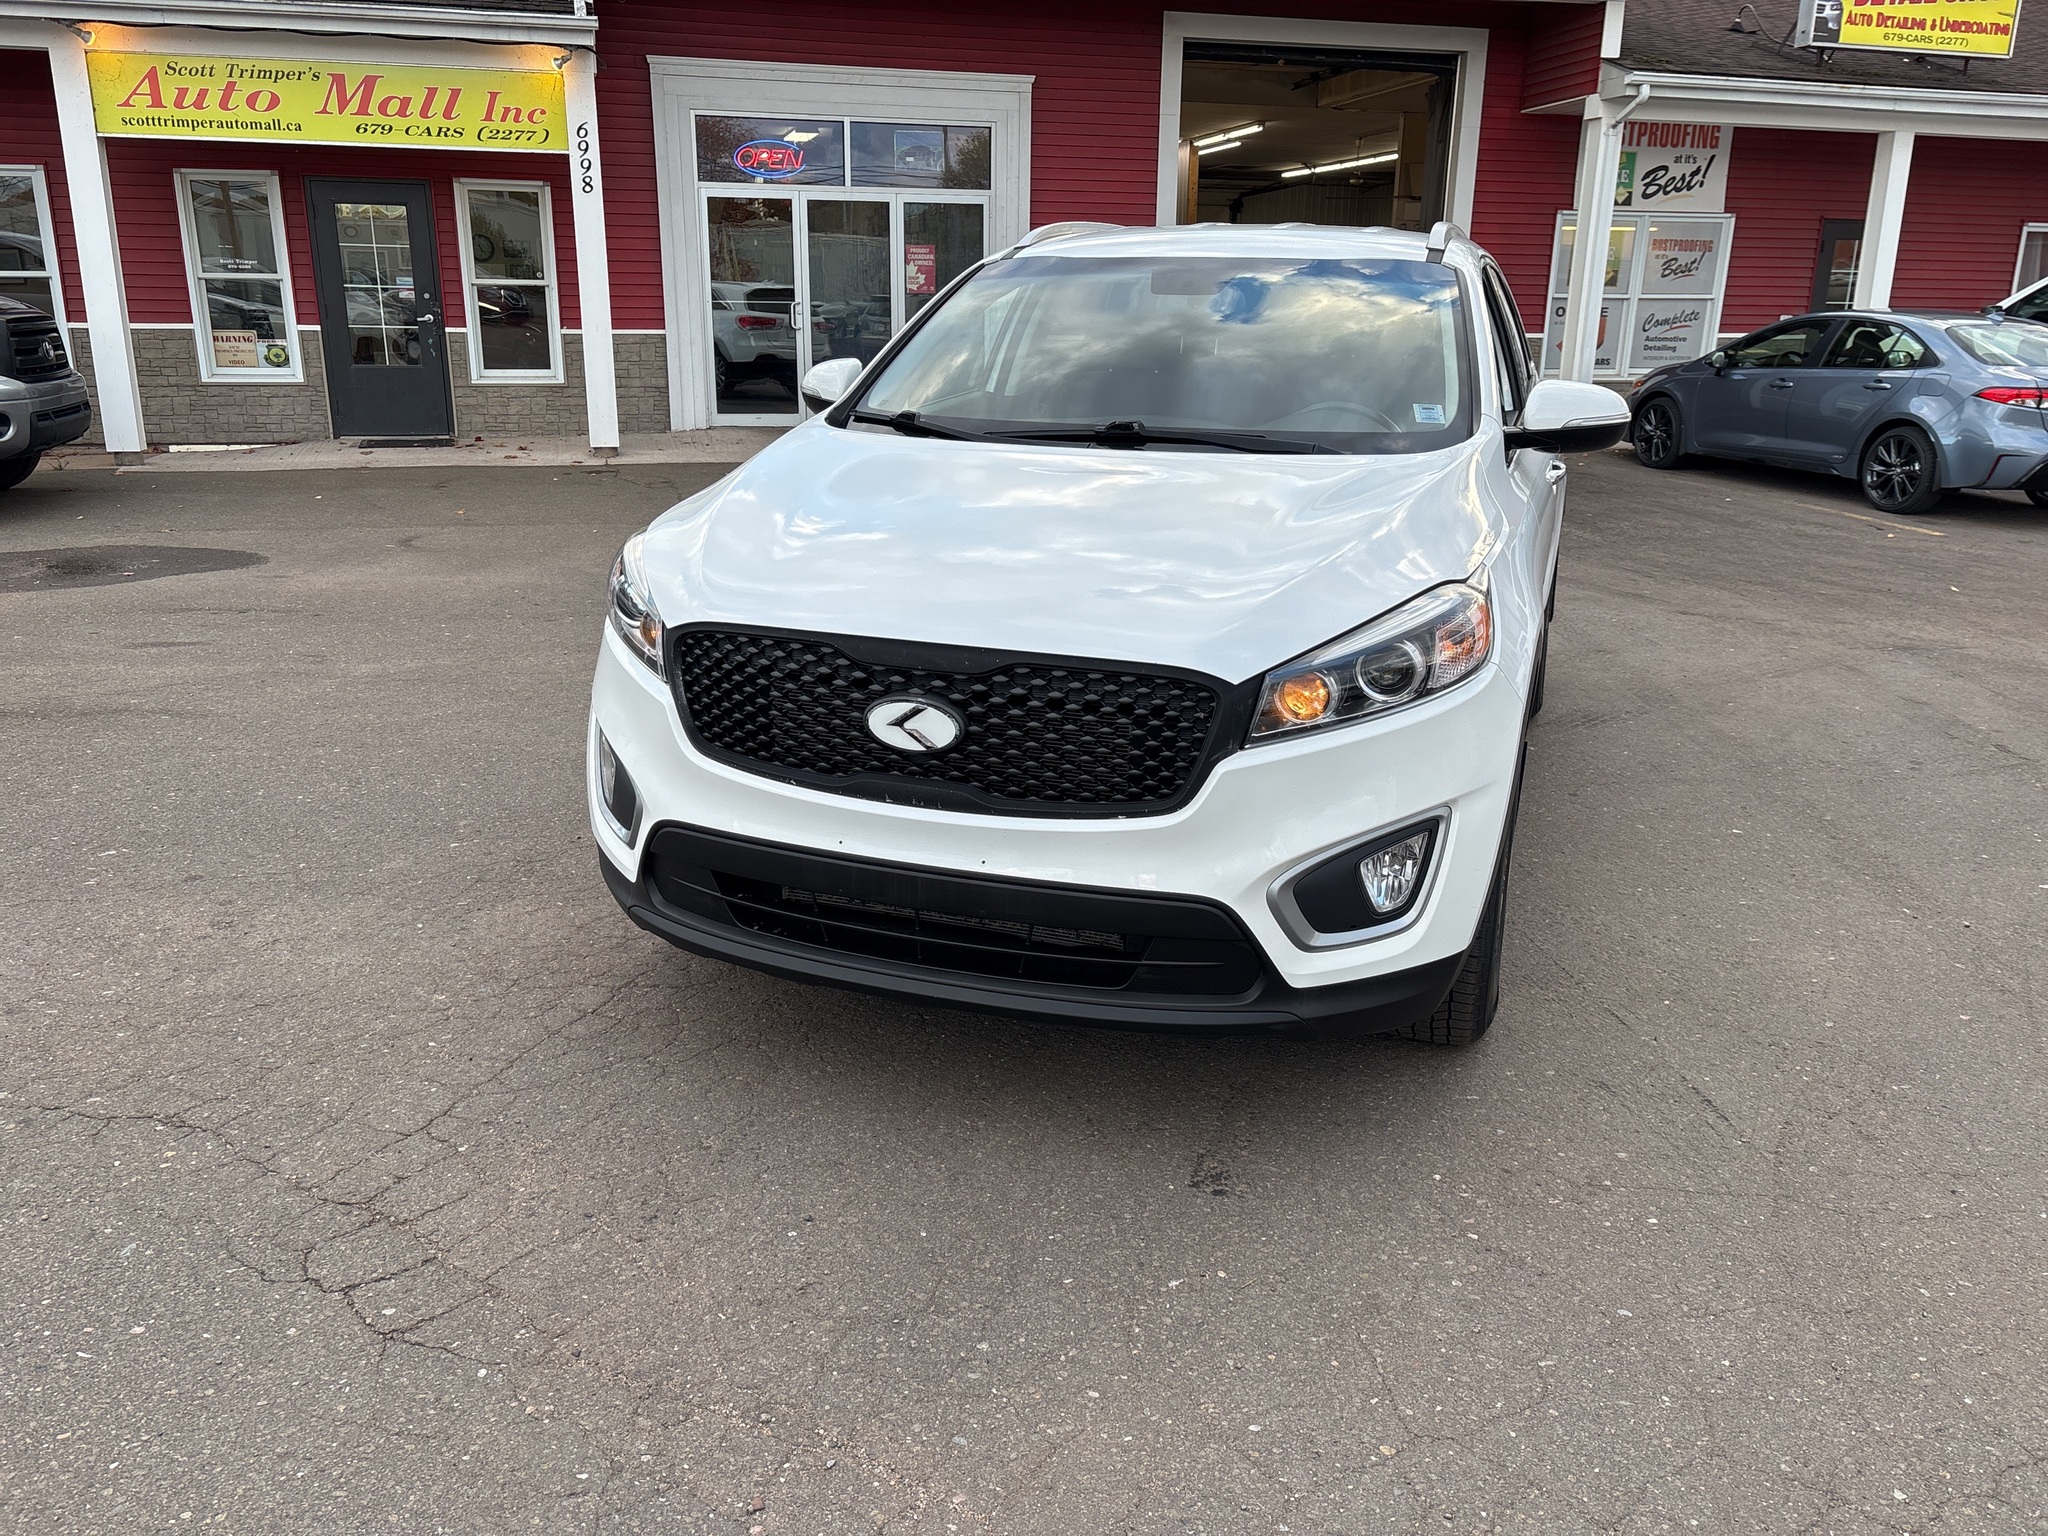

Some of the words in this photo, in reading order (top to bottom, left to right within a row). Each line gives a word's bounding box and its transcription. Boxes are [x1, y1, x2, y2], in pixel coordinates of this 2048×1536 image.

[1930, 18, 1937, 31] &
[1883, 33, 1933, 44] 679-CARS
[1936, 35, 1969, 47] (2277)
[165, 61, 216, 78] Scott
[225, 63, 321, 83] Trimper's
[116, 65, 281, 113] Auto
[314, 73, 463, 121] Mall
[479, 91, 547, 125] Inc
[121, 115, 302, 132] scotttrimperautomall.ca
[355, 123, 465, 139] 679-CARS
[477, 126, 550, 144] (2277)
[576, 122, 594, 193] 6998
[737, 147, 804, 169] OPEN
[1674, 155, 1682, 164] at
[1684, 154, 1697, 164] it's
[1640, 154, 1716, 199] Best!
[1652, 239, 1714, 252] RUSTPROOFING
[1660, 250, 1707, 278] Best!
[1642, 309, 1701, 332] Complete
[1643, 344, 1677, 352] Detailing
